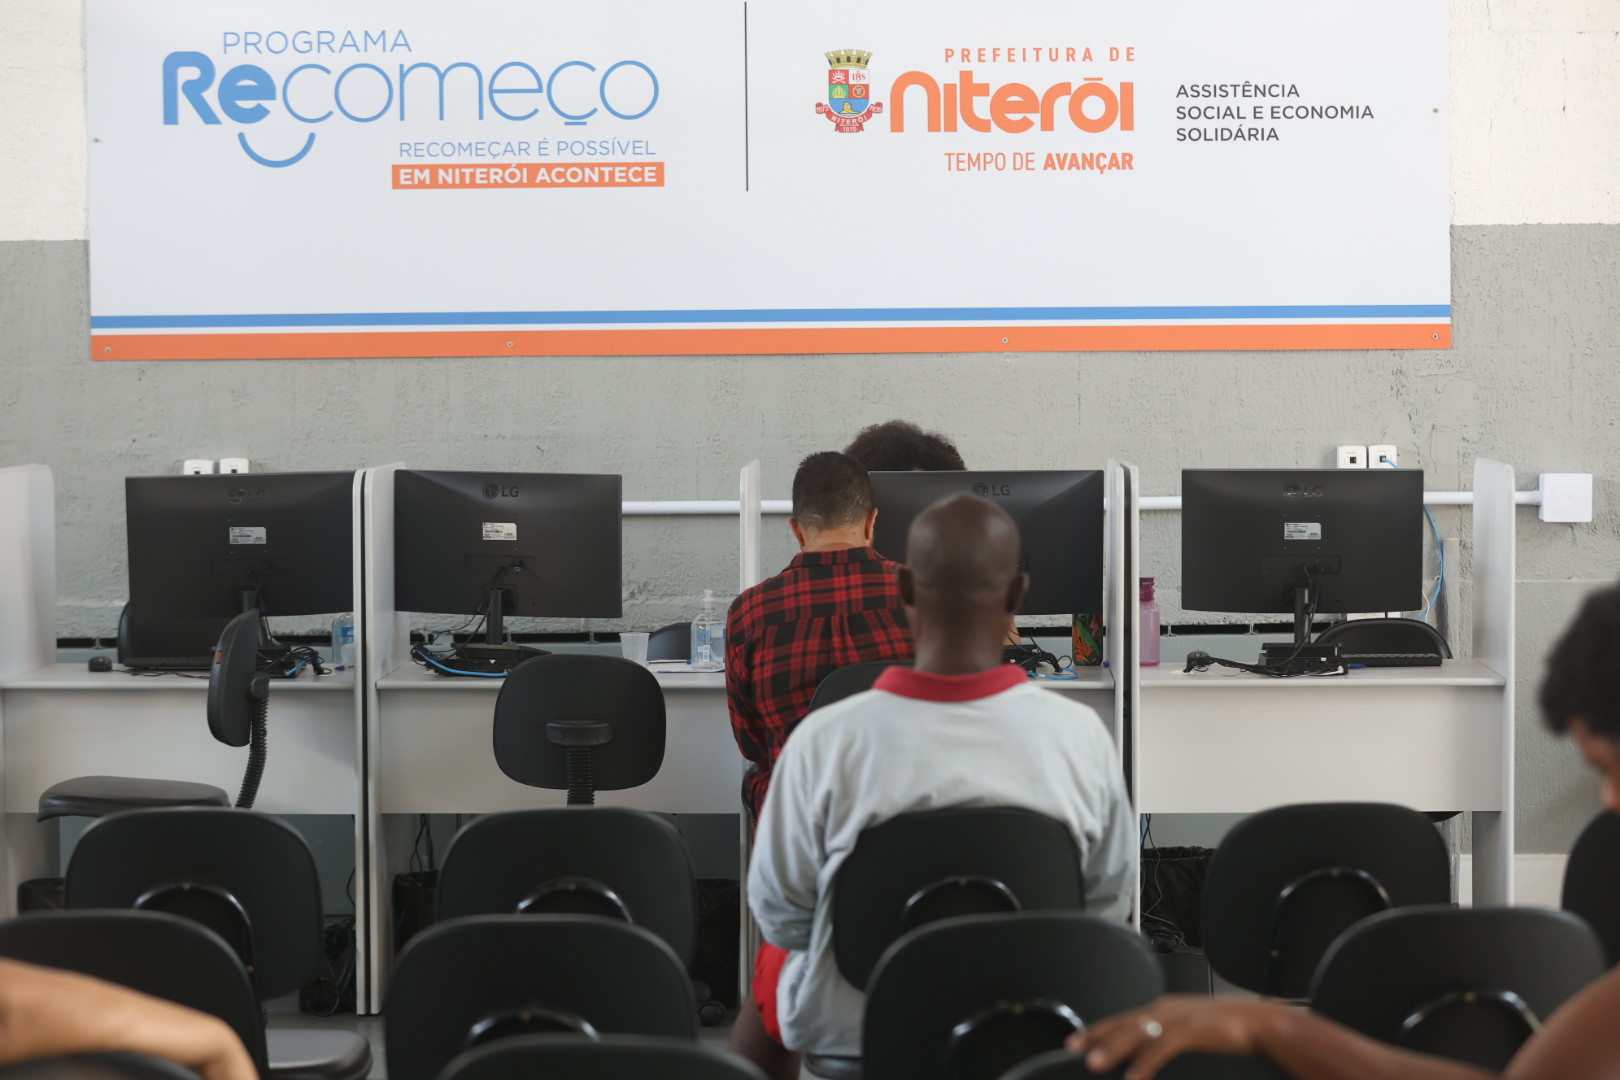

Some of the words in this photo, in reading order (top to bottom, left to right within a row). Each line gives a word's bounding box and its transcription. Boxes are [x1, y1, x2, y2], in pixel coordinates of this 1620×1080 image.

[223, 30, 412, 54] PROGRAMA
[945, 47, 1093, 63] PREFEITURA
[1109, 47, 1135, 62] DE
[162, 51, 660, 126] Recomeço
[1176, 81, 1300, 98] ASSISTÊNCIA
[1176, 105, 1247, 120] SOCIAL
[1253, 106, 1263, 119] E
[1271, 105, 1374, 120] ECONOMIA
[1176, 124, 1279, 142] SOLIDÁRIA
[399, 141, 530, 160] RECOMEÇAR
[538, 138, 549, 156] É
[557, 137, 656, 156] POSSÍVEL
[944, 152, 1006, 171] TEMPO
[1013, 152, 1036, 171] DE
[1043, 152, 1134, 175] AVANÇAR
[399, 168, 431, 185] EM
[438, 164, 528, 185] NITERÓI
[535, 166, 657, 183] ACONTECE
[501, 486, 519, 497] LG
[992, 484, 1010, 496] LG
